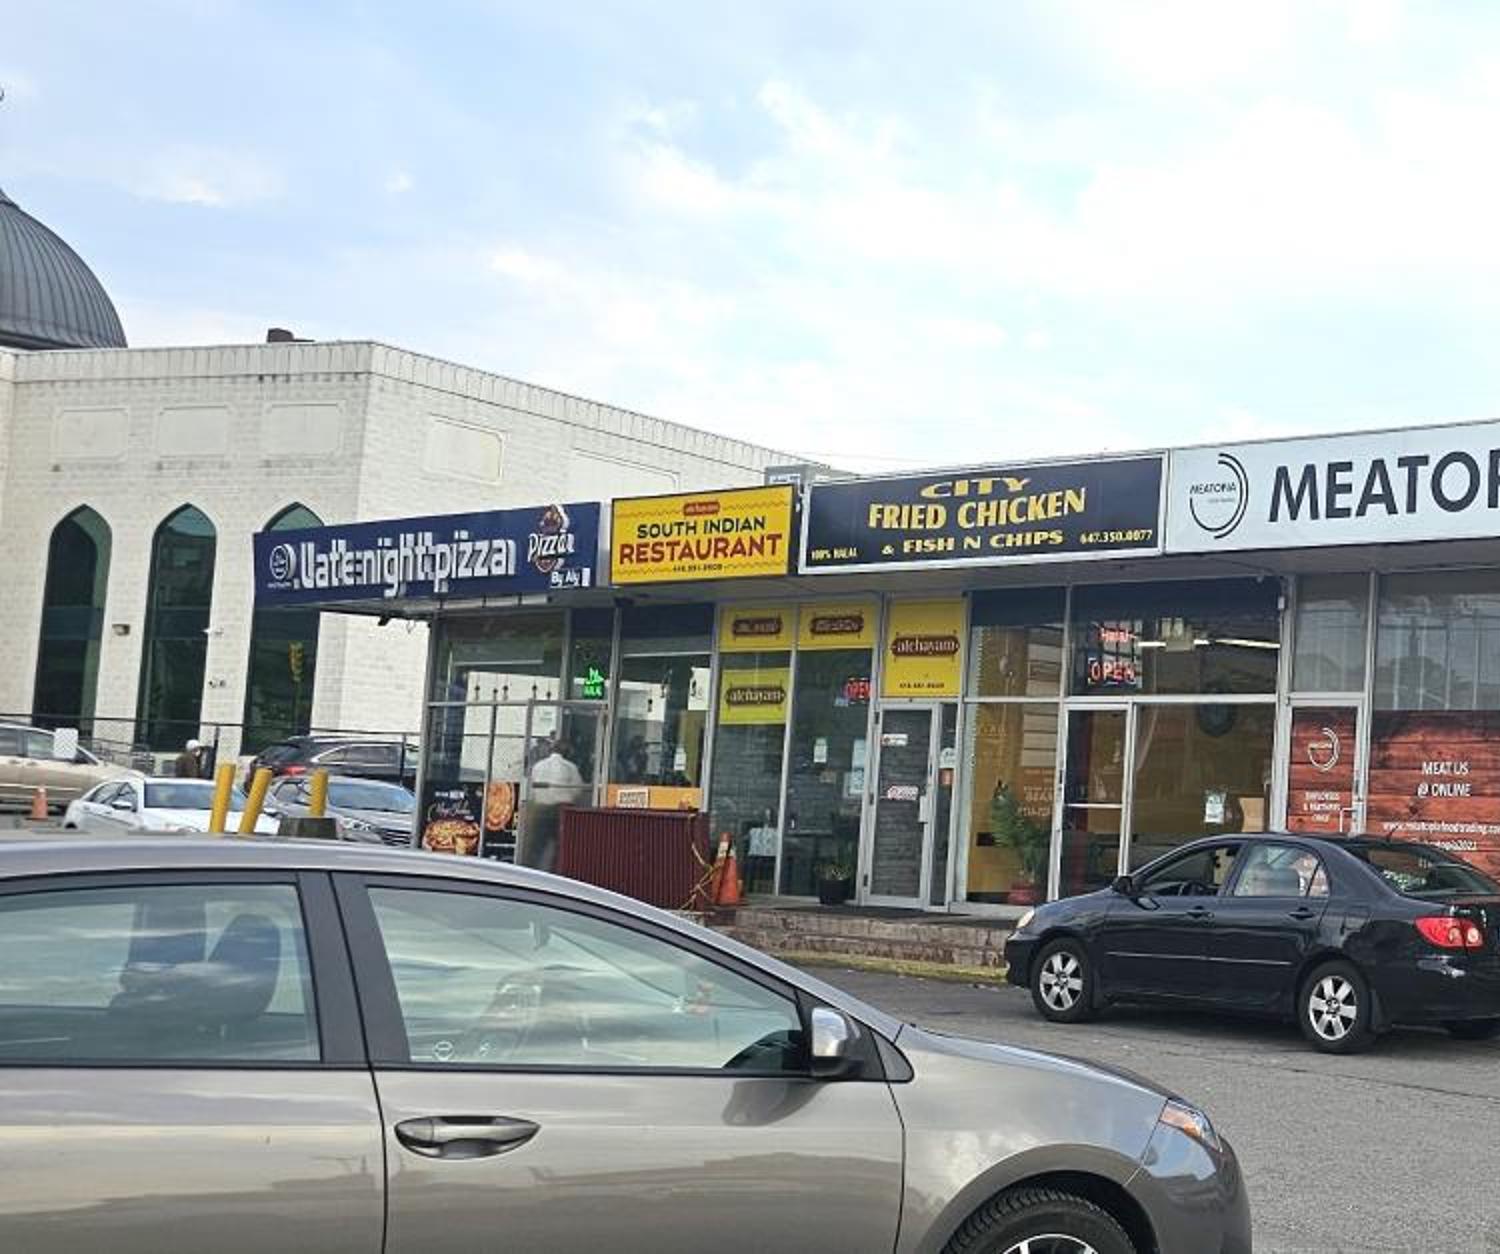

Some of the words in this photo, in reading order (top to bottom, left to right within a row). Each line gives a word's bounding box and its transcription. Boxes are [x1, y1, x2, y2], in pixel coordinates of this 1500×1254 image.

[919, 477, 1033, 499] CITY
[1189, 482, 1238, 496] MEATOPIA
[867, 503, 948, 530] FRIED
[956, 487, 1087, 529] CHICKEN
[637, 521, 697, 539] SOUTH
[703, 515, 767, 534] INDIAN
[619, 533, 783, 565] RESTAURANT
[881, 544, 895, 556] &
[903, 536, 955, 554] FISH
[963, 534, 981, 550] N
[989, 529, 1064, 548] CHIPS
[1091, 661, 1136, 681] OPEN
[1421, 761, 1451, 776] MEAT
[1453, 761, 1470, 776] US
[1431, 783, 1472, 798] ONLINE
